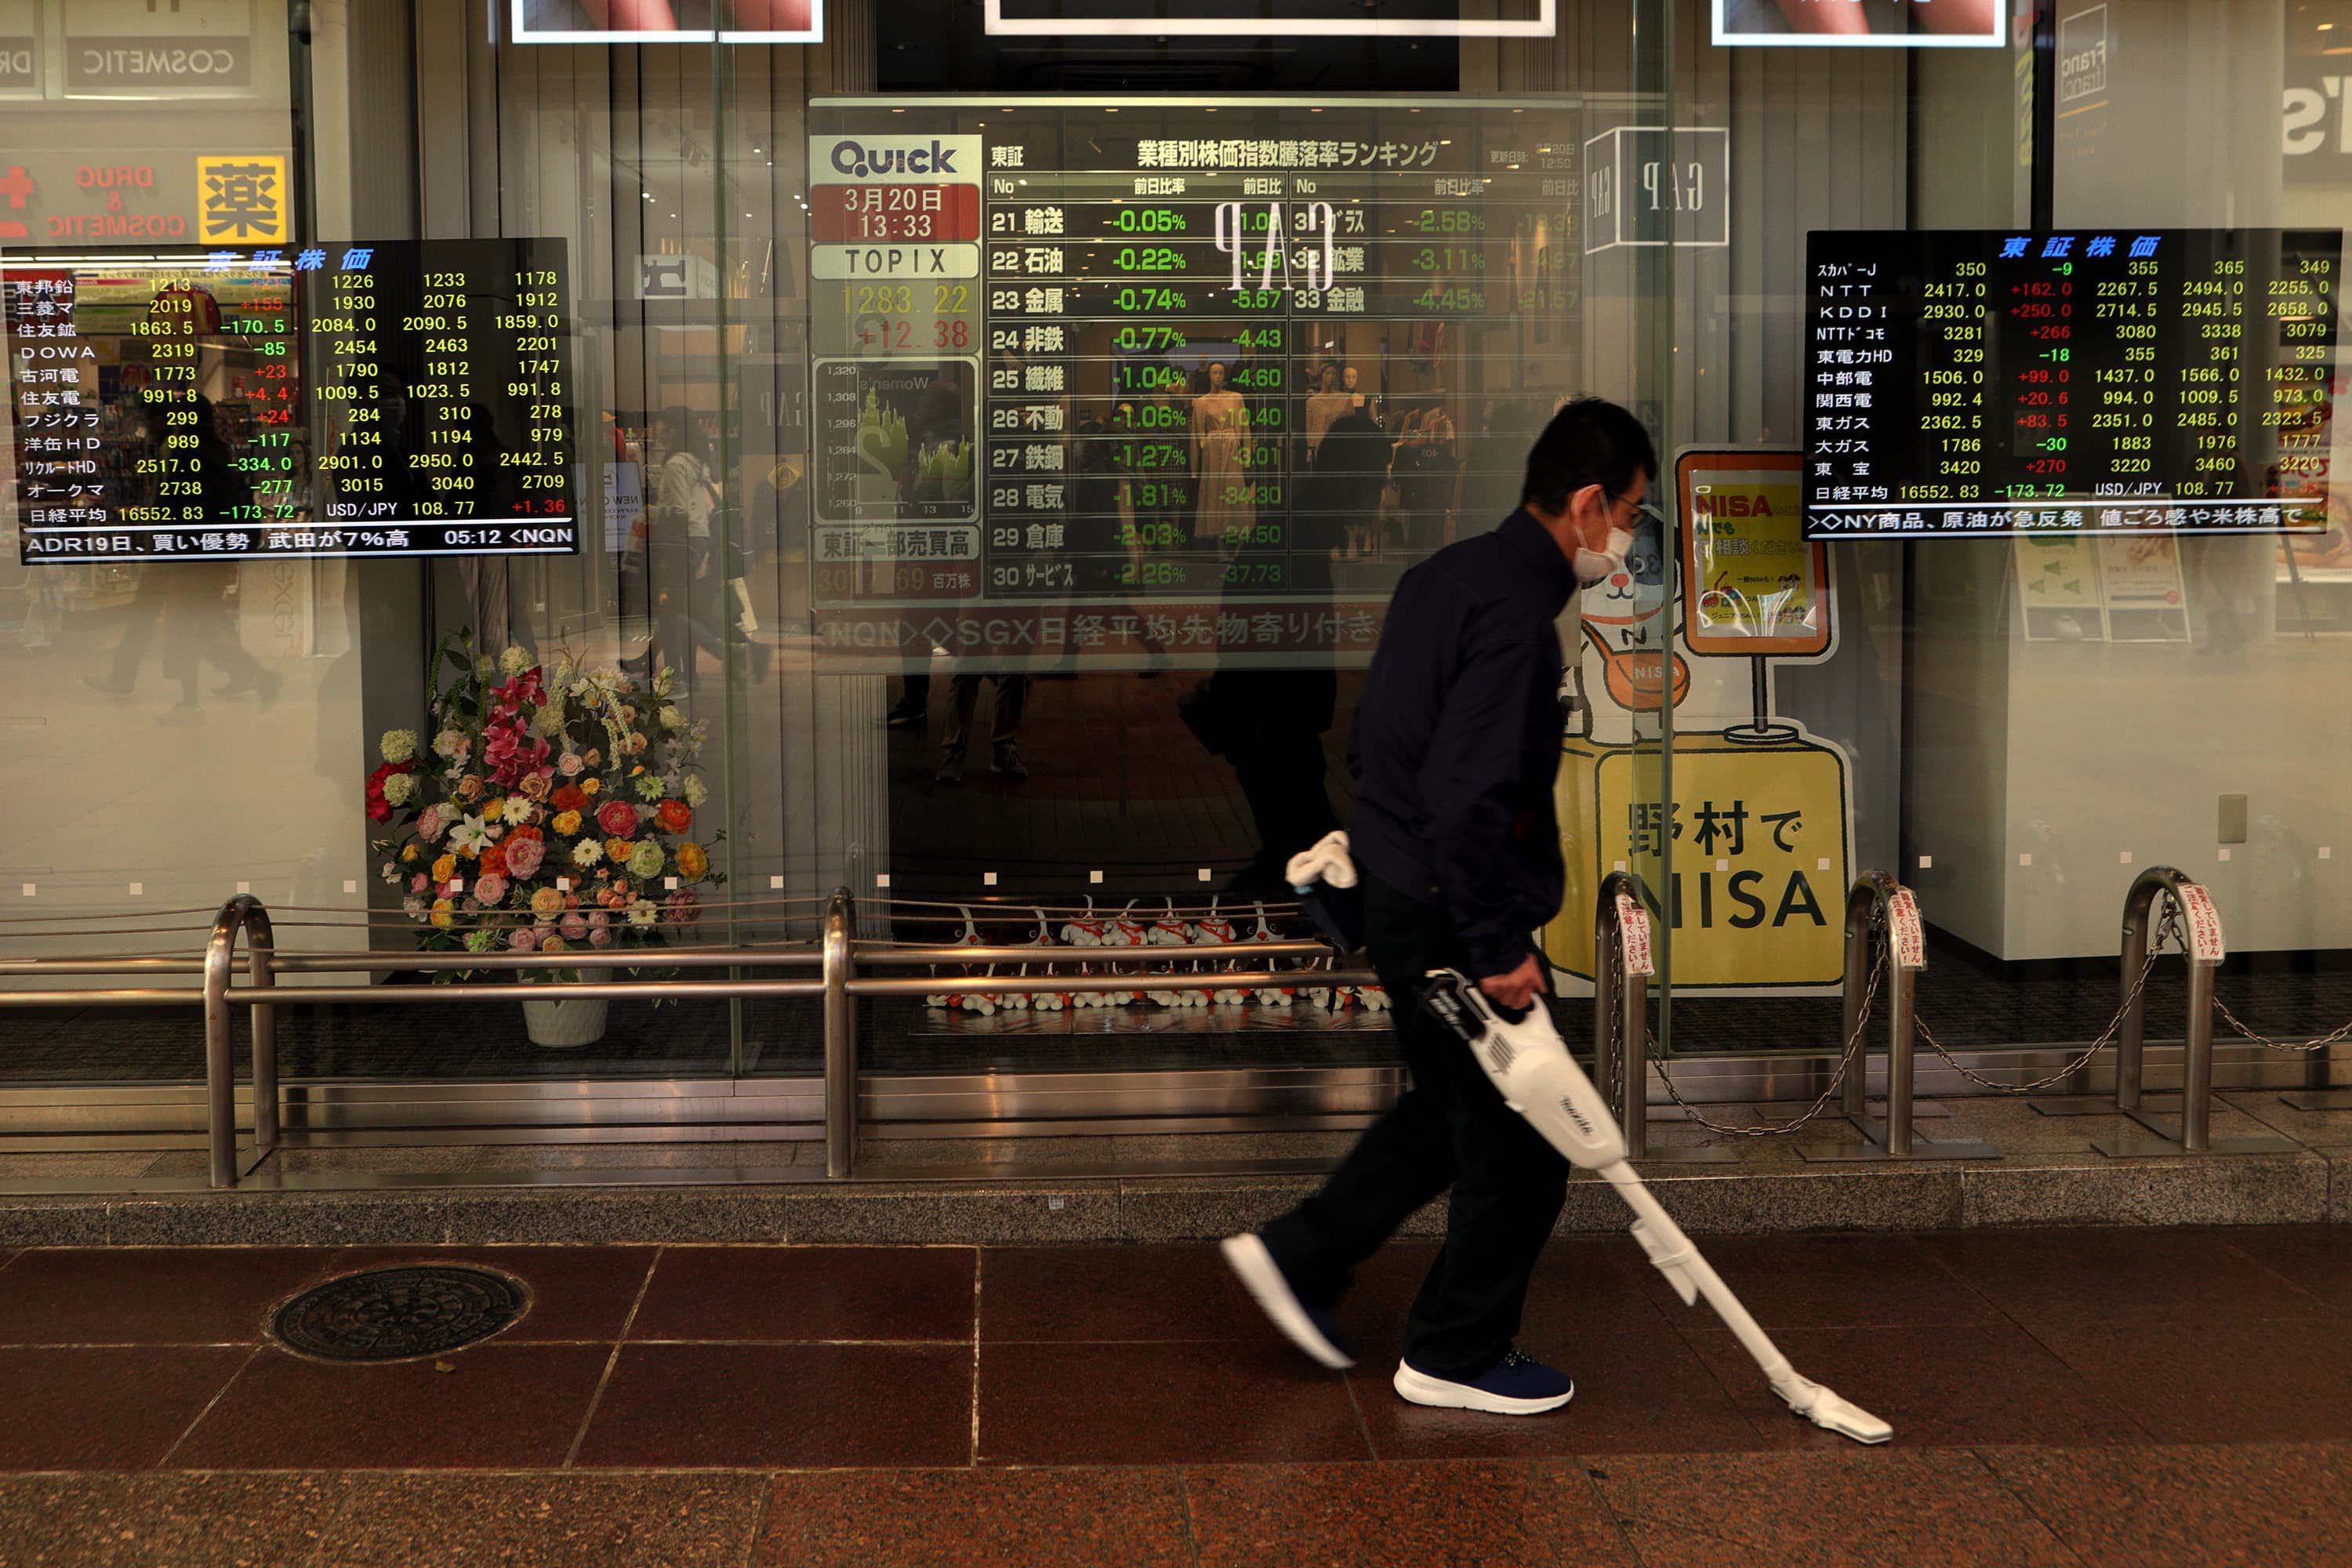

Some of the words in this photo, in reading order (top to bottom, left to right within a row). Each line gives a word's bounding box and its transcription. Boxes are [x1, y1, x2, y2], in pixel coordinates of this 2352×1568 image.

[991, 146, 1024, 167] 東証
[1137, 140, 1439, 168] 業種別株価指数騰落率ランキング
[994, 180, 1014, 194] No
[1134, 177, 1185, 194] 前日比率
[1243, 177, 1282, 194] 前日比
[1296, 180, 1316, 193] No
[1434, 179, 1485, 195] 前日比率
[844, 188, 942, 212] 3月20日
[861, 215, 931, 237] 13:33
[992, 213, 1015, 231] 21
[1025, 209, 1064, 234] 輸送
[1112, 210, 1186, 231] -0.05%
[1413, 211, 1486, 232] -2.58%
[1998, 235, 2161, 259] 東証株価
[204, 248, 374, 272] 東証株価
[844, 249, 946, 273] TOPIX
[993, 252, 1019, 270] 22
[1025, 248, 1064, 273] 石油
[1112, 249, 1186, 270] -0.22%
[1413, 249, 1486, 270] -3.11%
[1955, 263, 1986, 276] 350
[16, 280, 74, 294] 東邦鉛
[149, 278, 191, 292] 1213
[1820, 285, 1872, 297] NTT
[16, 302, 74, 315] 三菱マ
[150, 299, 192, 314] 2019
[241, 299, 283, 311] +155
[842, 285, 968, 314] 1283.22
[993, 292, 1018, 309] 23
[1025, 288, 1064, 313] 金属
[1112, 289, 1186, 310] -0.74%
[1232, 290, 1282, 308] -5.67
[1294, 290, 1320, 307] 33
[1327, 287, 1364, 313] 金融
[1413, 289, 1486, 310] -4.45%
[1820, 307, 1887, 318] KDDI
[16, 324, 77, 337] 住友鉱
[993, 332, 1019, 349] 24
[1025, 326, 1064, 351] 非鉄
[1112, 327, 1186, 349] -0.77%
[1232, 329, 1282, 347] -4.43
[1944, 326, 1982, 340] 3281
[20, 347, 96, 358] DOWA
[152, 344, 194, 358] 2319
[253, 342, 286, 356] -85
[1817, 349, 1893, 364] 東電力HD
[1953, 349, 1984, 362] 329
[20, 369, 79, 383] 古河電
[155, 367, 195, 380] 1773
[254, 366, 287, 379] +23
[993, 371, 1019, 389] 25
[1025, 365, 1064, 392] 繊維
[1112, 367, 1186, 388] -1.04%
[1232, 369, 1281, 387] -4.60
[1817, 372, 1872, 386] 中部電
[20, 391, 80, 405] 住友電
[1816, 394, 1872, 408] 関西電
[24, 414, 100, 427] フジクラ
[166, 412, 198, 426] 299
[257, 411, 289, 423] +24
[993, 409, 1019, 428] 26
[1025, 405, 1064, 431] 不動
[1112, 406, 1186, 427] -1.06%
[1219, 408, 1281, 426] -10.40
[1816, 416, 1870, 430] 東ガス
[24, 437, 101, 452] 洋缶HD
[168, 435, 199, 448] 989
[248, 434, 290, 447] -117
[1816, 439, 1869, 453] 大ガス
[1941, 438, 1981, 452] 1786
[993, 449, 1019, 467] 27
[1025, 445, 1064, 470] 鉄鋼
[1112, 445, 1186, 467] -1.27%
[1232, 448, 1279, 465] -3.01
[1815, 462, 1870, 476] 東宝
[1940, 461, 1980, 474] 3420
[27, 484, 105, 498] オークマ
[160, 481, 202, 495] 2738
[250, 480, 293, 494] -277
[993, 488, 1019, 507] 28
[1025, 484, 1064, 509] 電気
[1112, 485, 1186, 506] -1.81%
[1219, 486, 1281, 504] -34.30
[1816, 486, 1888, 500] 日経平均
[2095, 482, 2162, 496] USD/JPY
[2176, 481, 2234, 495] 108.77
[31, 510, 107, 523] 日経平均
[327, 503, 397, 518] USD/JPY
[413, 501, 474, 515] 108.77
[1695, 495, 1773, 518] NISA
[2100, 506, 2303, 526] 値ごろ感や米株高で
[26, 533, 250, 553] ADR19日、買い優勢
[268, 529, 410, 550] 武田が7%高
[444, 530, 502, 544] 05:12
[822, 531, 970, 557] 東証一部売買高
[993, 528, 1019, 546] 29
[1026, 524, 1064, 548] 倉庫
[1112, 524, 1186, 545] -2.03%
[1219, 525, 1281, 543] -24.50
[932, 573, 971, 590] 百万株
[993, 567, 1019, 585] 30
[1026, 564, 1073, 586] サービス
[1112, 564, 1186, 585] -2.26%
[1220, 564, 1281, 582] -37.73
[1628, 800, 1802, 856] 野村で
[1633, 870, 1827, 929] NISA
